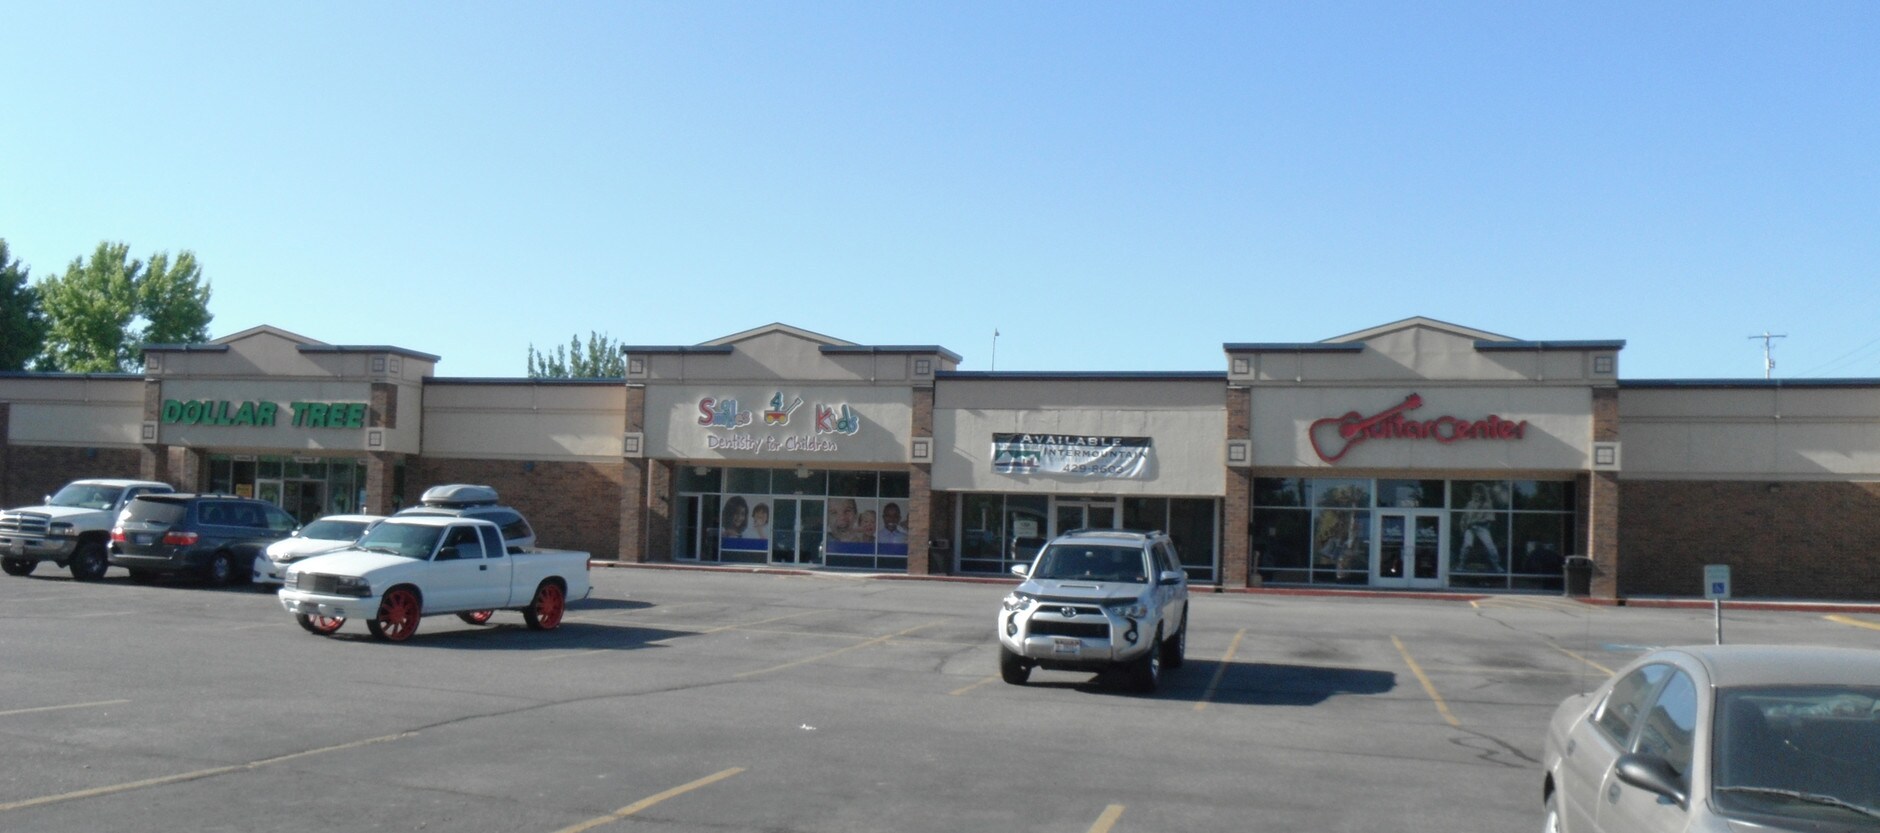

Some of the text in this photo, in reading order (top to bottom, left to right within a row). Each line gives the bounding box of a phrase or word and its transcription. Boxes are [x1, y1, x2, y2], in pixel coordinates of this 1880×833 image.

[162, 400, 367, 428] DOLLAR TREE
[770, 392, 784, 412] 4
[815, 403, 859, 434] Kids
[707, 435, 838, 454] Dentistry for Children
[1020, 434, 1122, 446] AVAILABLE
